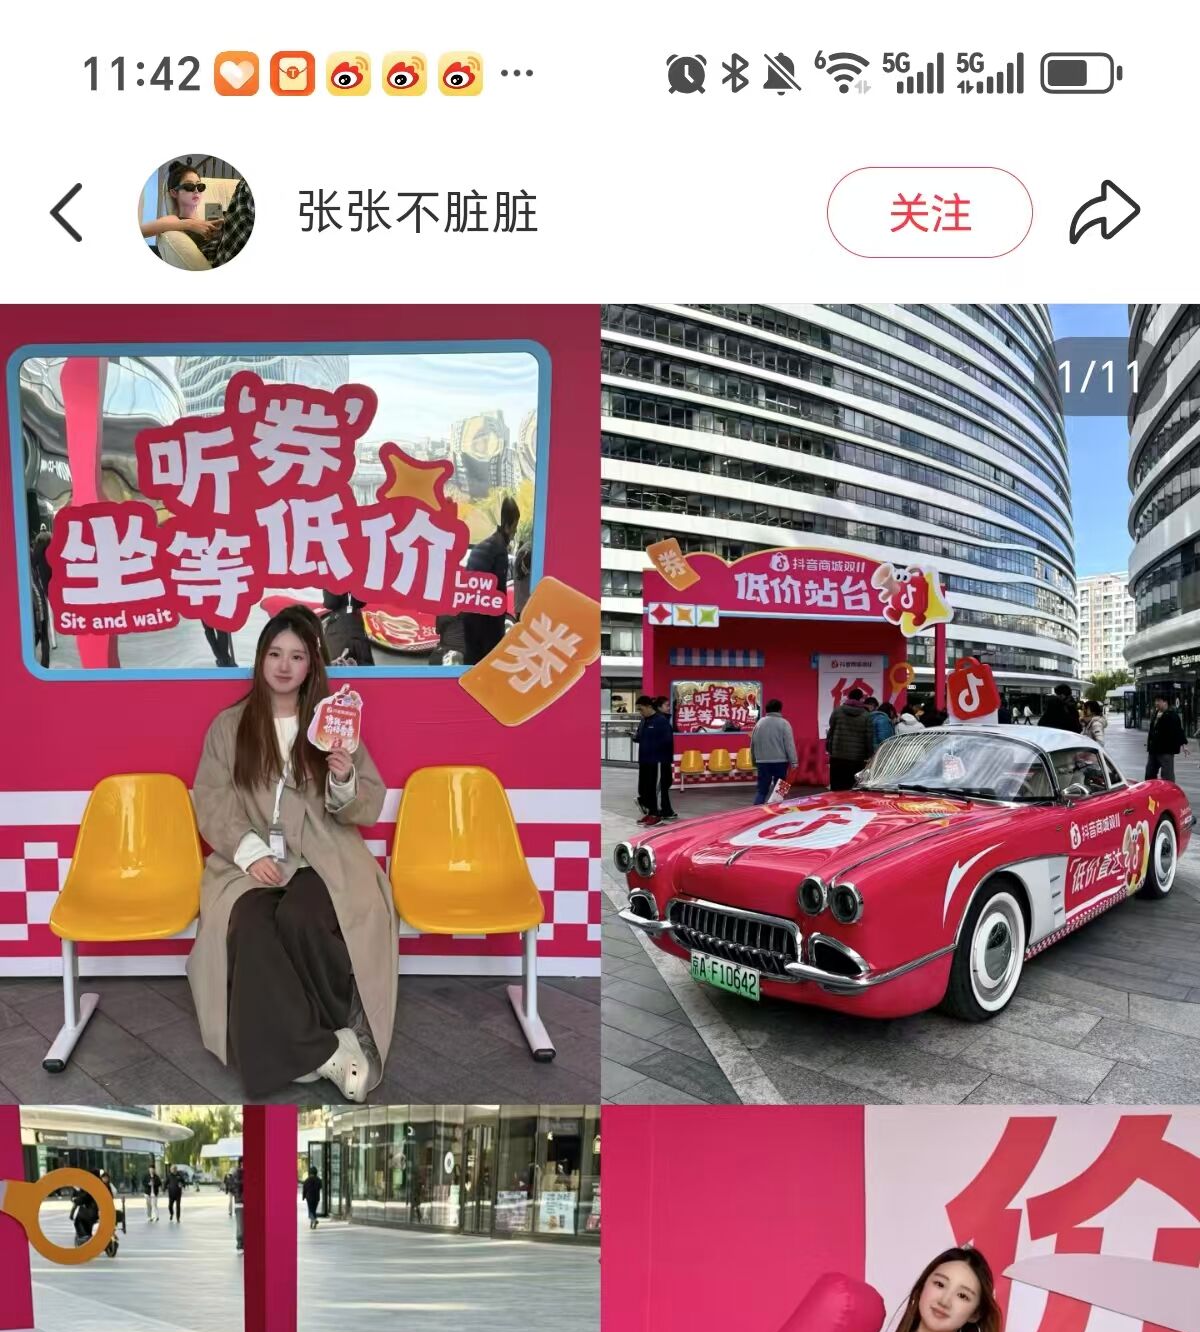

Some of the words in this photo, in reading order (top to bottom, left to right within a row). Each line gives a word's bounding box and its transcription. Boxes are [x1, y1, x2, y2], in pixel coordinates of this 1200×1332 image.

[882, 52, 911, 73] 5G
[956, 52, 985, 73] 5G
[84, 56, 201, 92] 11:42
[298, 189, 539, 234] 张张不脏脏
[889, 192, 972, 233] 关注
[61, 497, 457, 619] 坐等低价
[792, 556, 866, 574] 抖音商城双11
[455, 571, 493, 590] Low
[452, 590, 503, 608] price
[733, 571, 872, 612] 低价站台
[60, 612, 86, 629] Sit
[92, 610, 128, 629] and
[133, 608, 173, 627] wait
[490, 611, 583, 694] 券
[678, 704, 748, 724] 坐等低价
